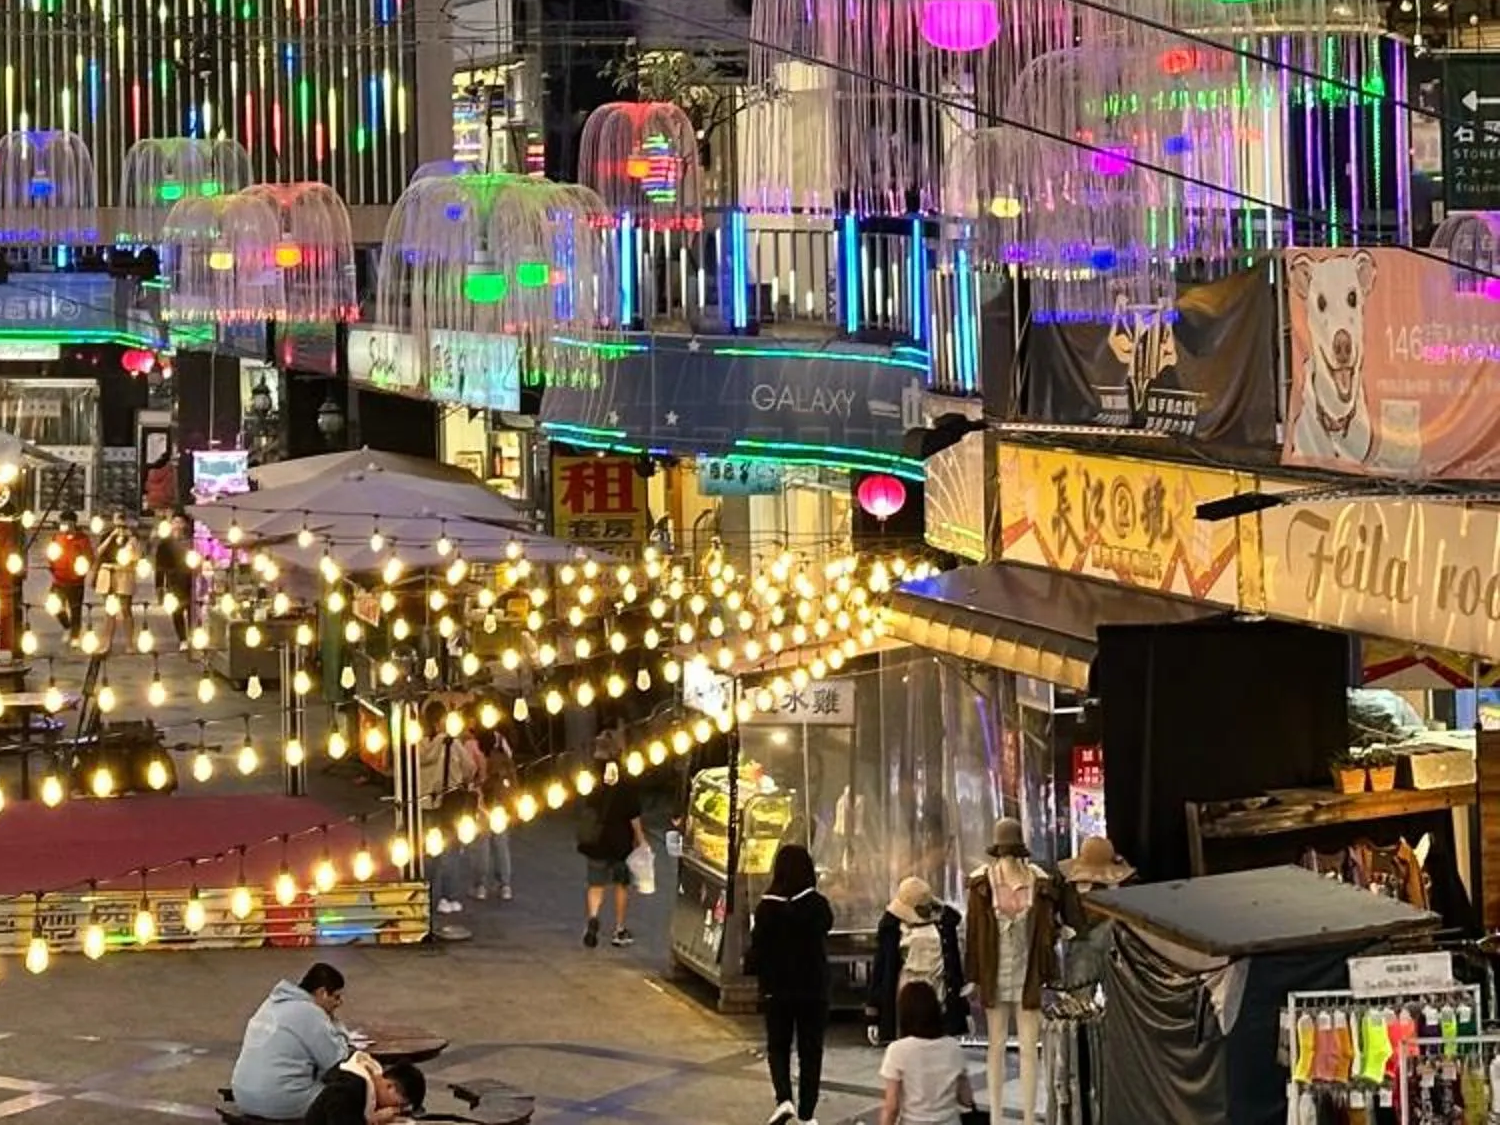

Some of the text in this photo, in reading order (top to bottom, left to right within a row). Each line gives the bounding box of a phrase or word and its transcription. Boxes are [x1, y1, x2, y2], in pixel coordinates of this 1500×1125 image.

[752, 383, 856, 417] GALAXY
[561, 460, 639, 514] 租
[1286, 509, 1413, 604] Feila
